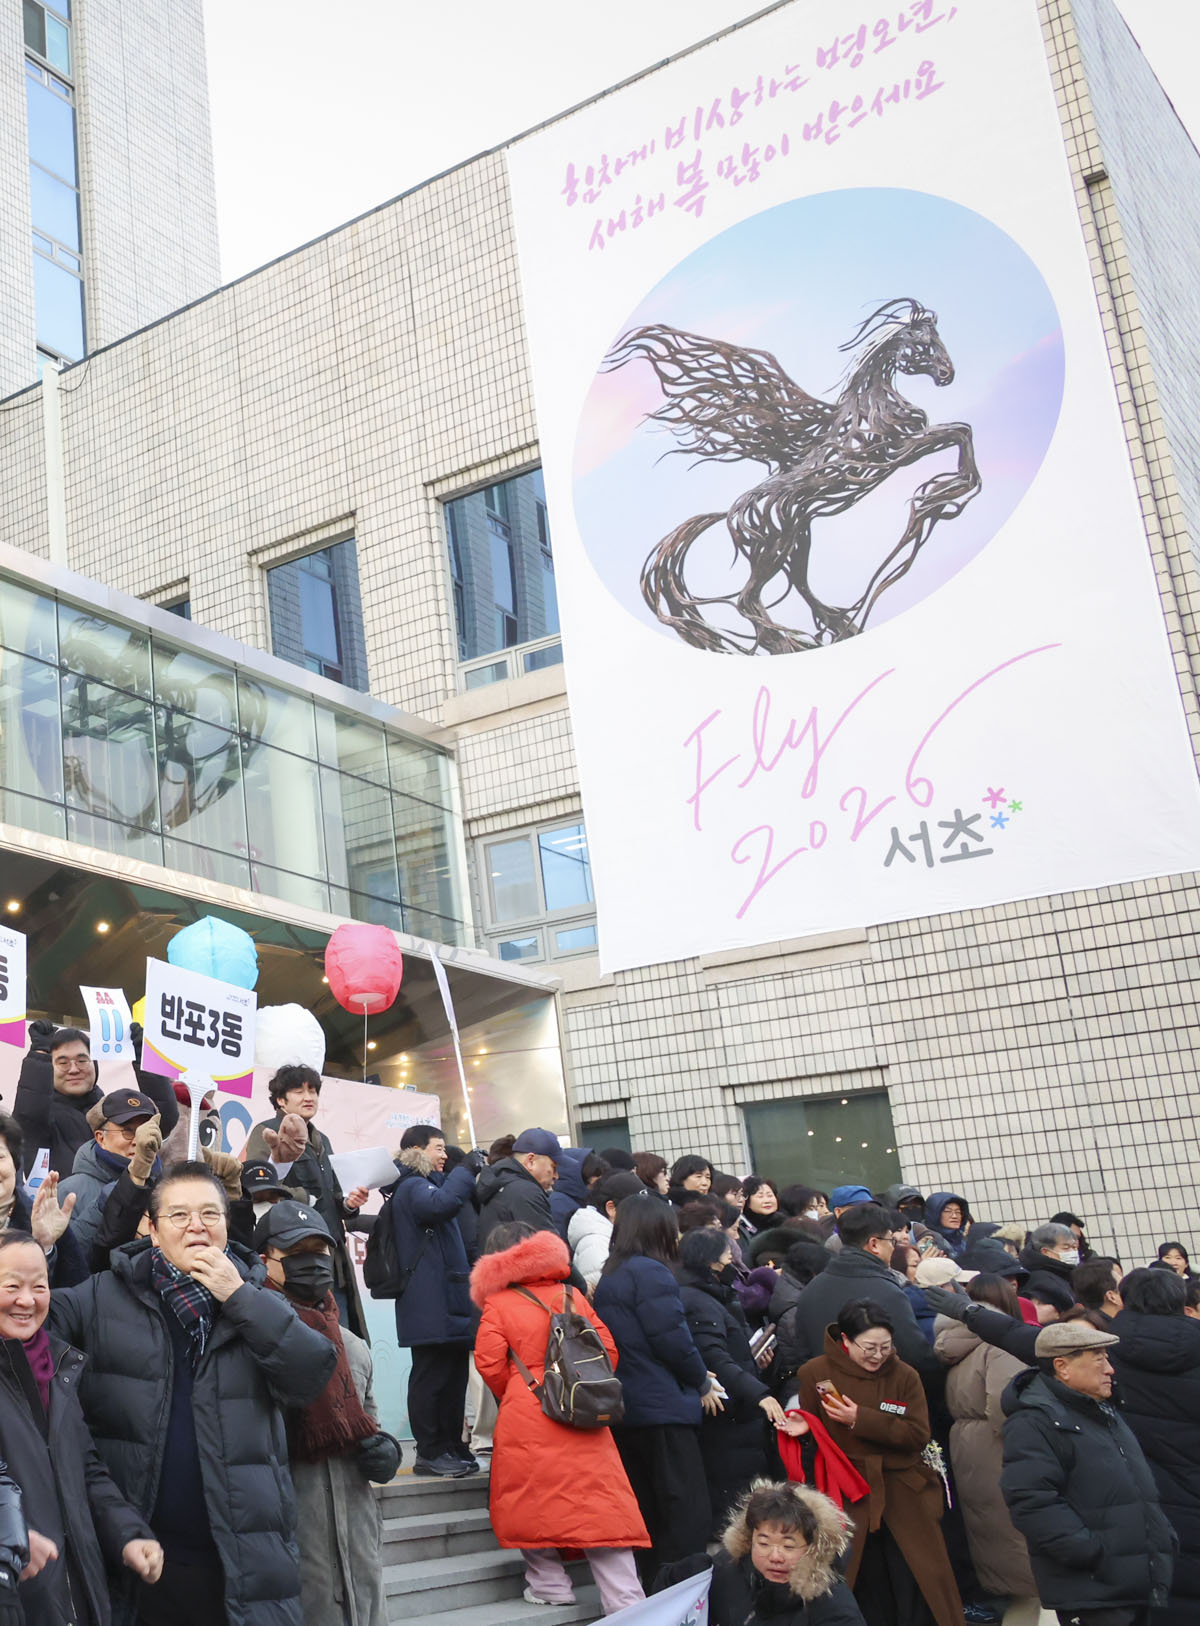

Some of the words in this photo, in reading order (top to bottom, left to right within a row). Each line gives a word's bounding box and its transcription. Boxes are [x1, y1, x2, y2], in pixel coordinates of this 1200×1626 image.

[561, 139, 655, 207] 힘차게
[665, 64, 810, 150] 비상하는
[588, 192, 665, 251] 새해
[673, 149, 709, 218] 복
[717, 133, 790, 187] 많이
[802, 60, 945, 145] 받으세요
[683, 667, 896, 831] Fly
[731, 643, 1063, 919] 2026
[883, 808, 994, 868] 서초
[161, 992, 243, 1058] 반포3동
